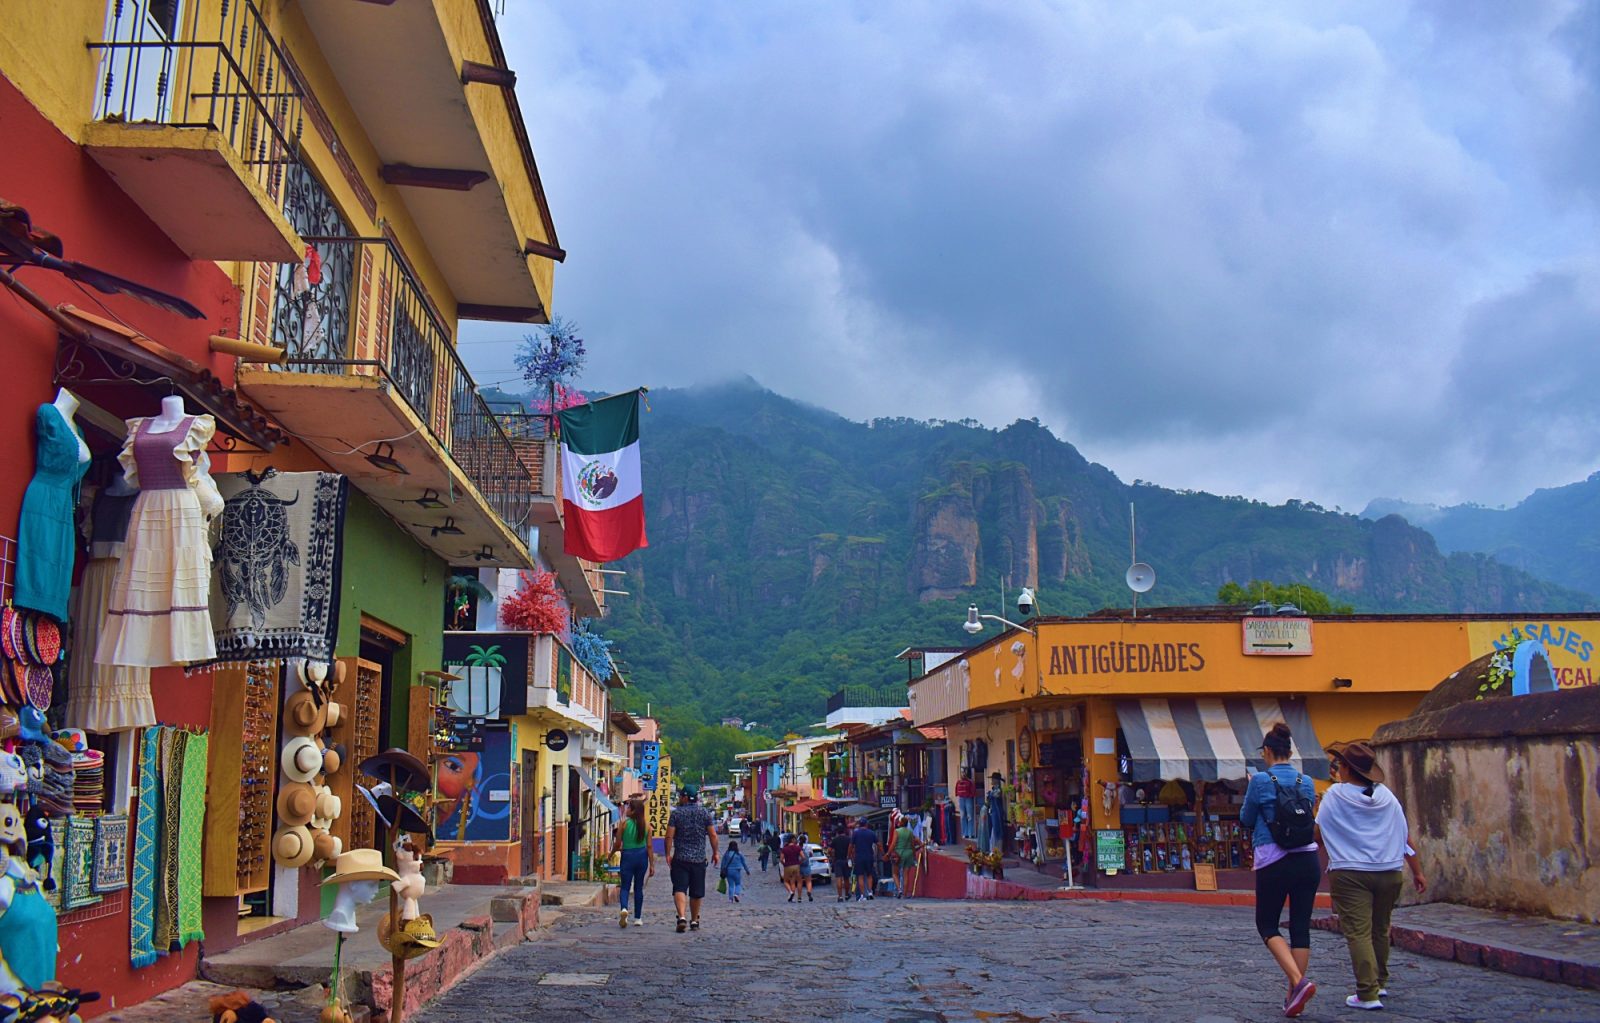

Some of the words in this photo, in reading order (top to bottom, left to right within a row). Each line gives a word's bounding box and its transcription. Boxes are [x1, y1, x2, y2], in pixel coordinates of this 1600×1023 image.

[1048, 641, 1205, 676] ANTIGÜEDADES
[1552, 667, 1597, 687] ZCAL
[644, 745, 657, 790] HOTL
[660, 766, 669, 784] SPA
[649, 790, 658, 837] AURANT
[660, 789, 669, 837] TEMAZCAL
[1098, 854, 1117, 862] BAR
